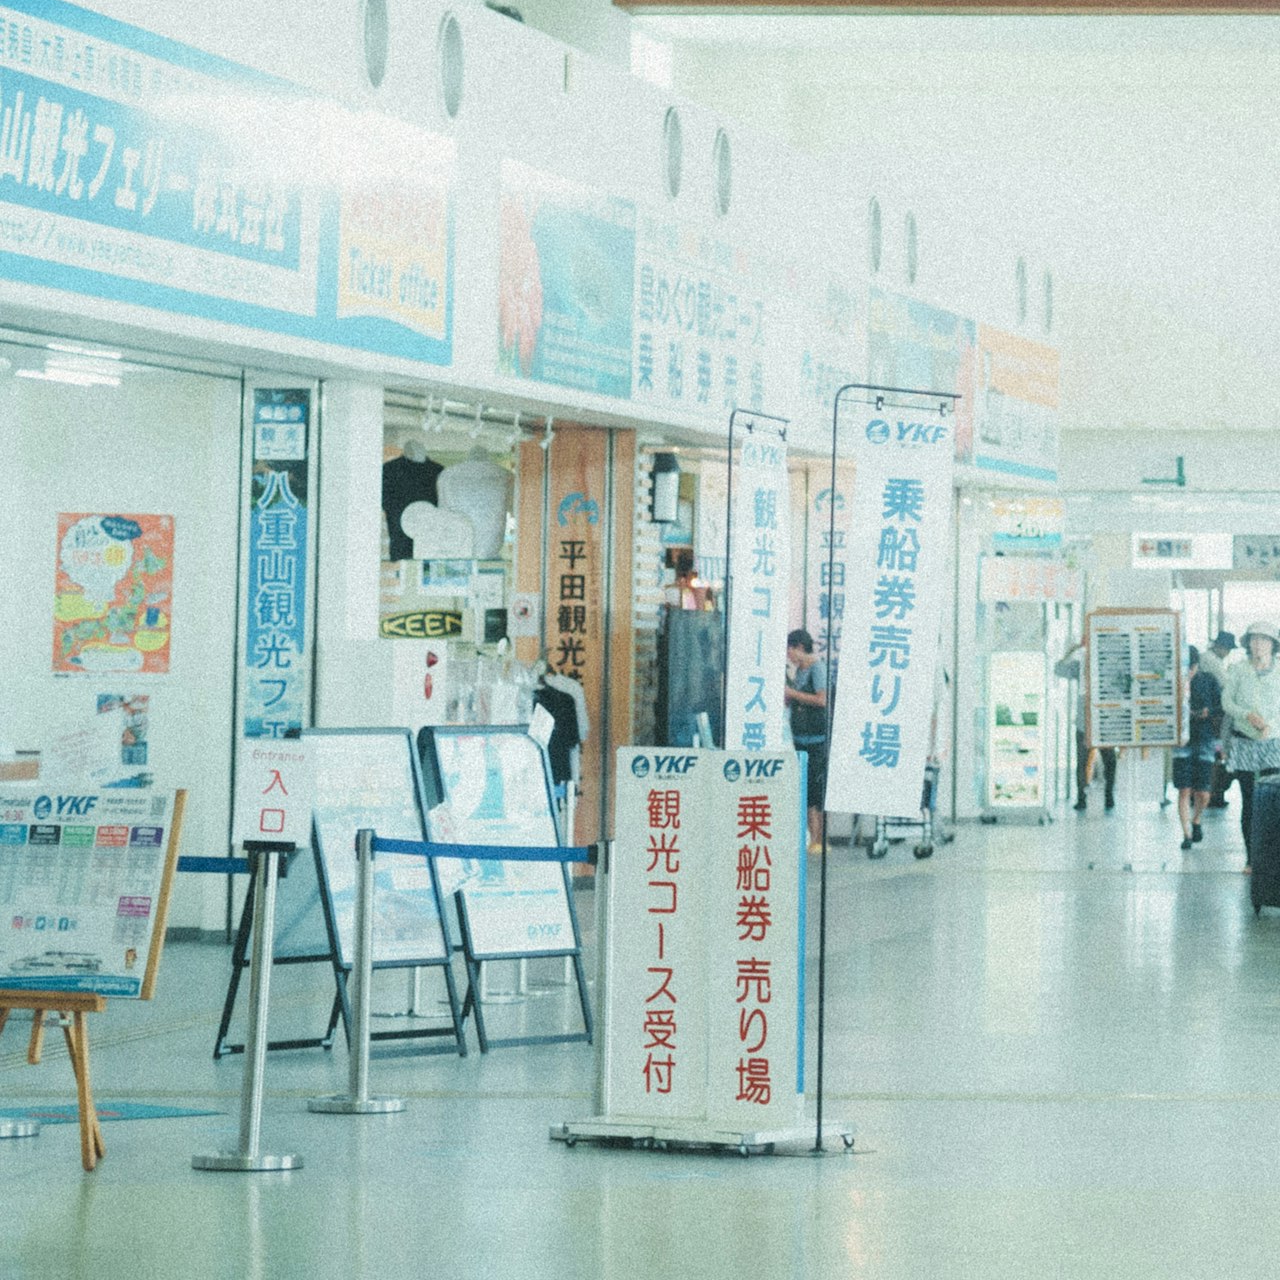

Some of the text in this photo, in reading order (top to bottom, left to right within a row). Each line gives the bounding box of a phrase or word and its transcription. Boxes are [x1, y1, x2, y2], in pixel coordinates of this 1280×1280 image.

[348, 245, 439, 309] Ticket office
[896, 420, 949, 444] YKF
[383, 613, 463, 637] KEEN
[858, 478, 925, 769] 乗船券売り場
[252, 749, 305, 762] Entrance
[653, 754, 698, 775] YKF
[743, 757, 785, 778] YKF
[56, 795, 98, 816] YKF
[260, 768, 289, 833] 入口
[735, 794, 773, 943] 乗船券
[641, 787, 682, 1095] 観光コース受付
[735, 956, 773, 1106] 売り場
